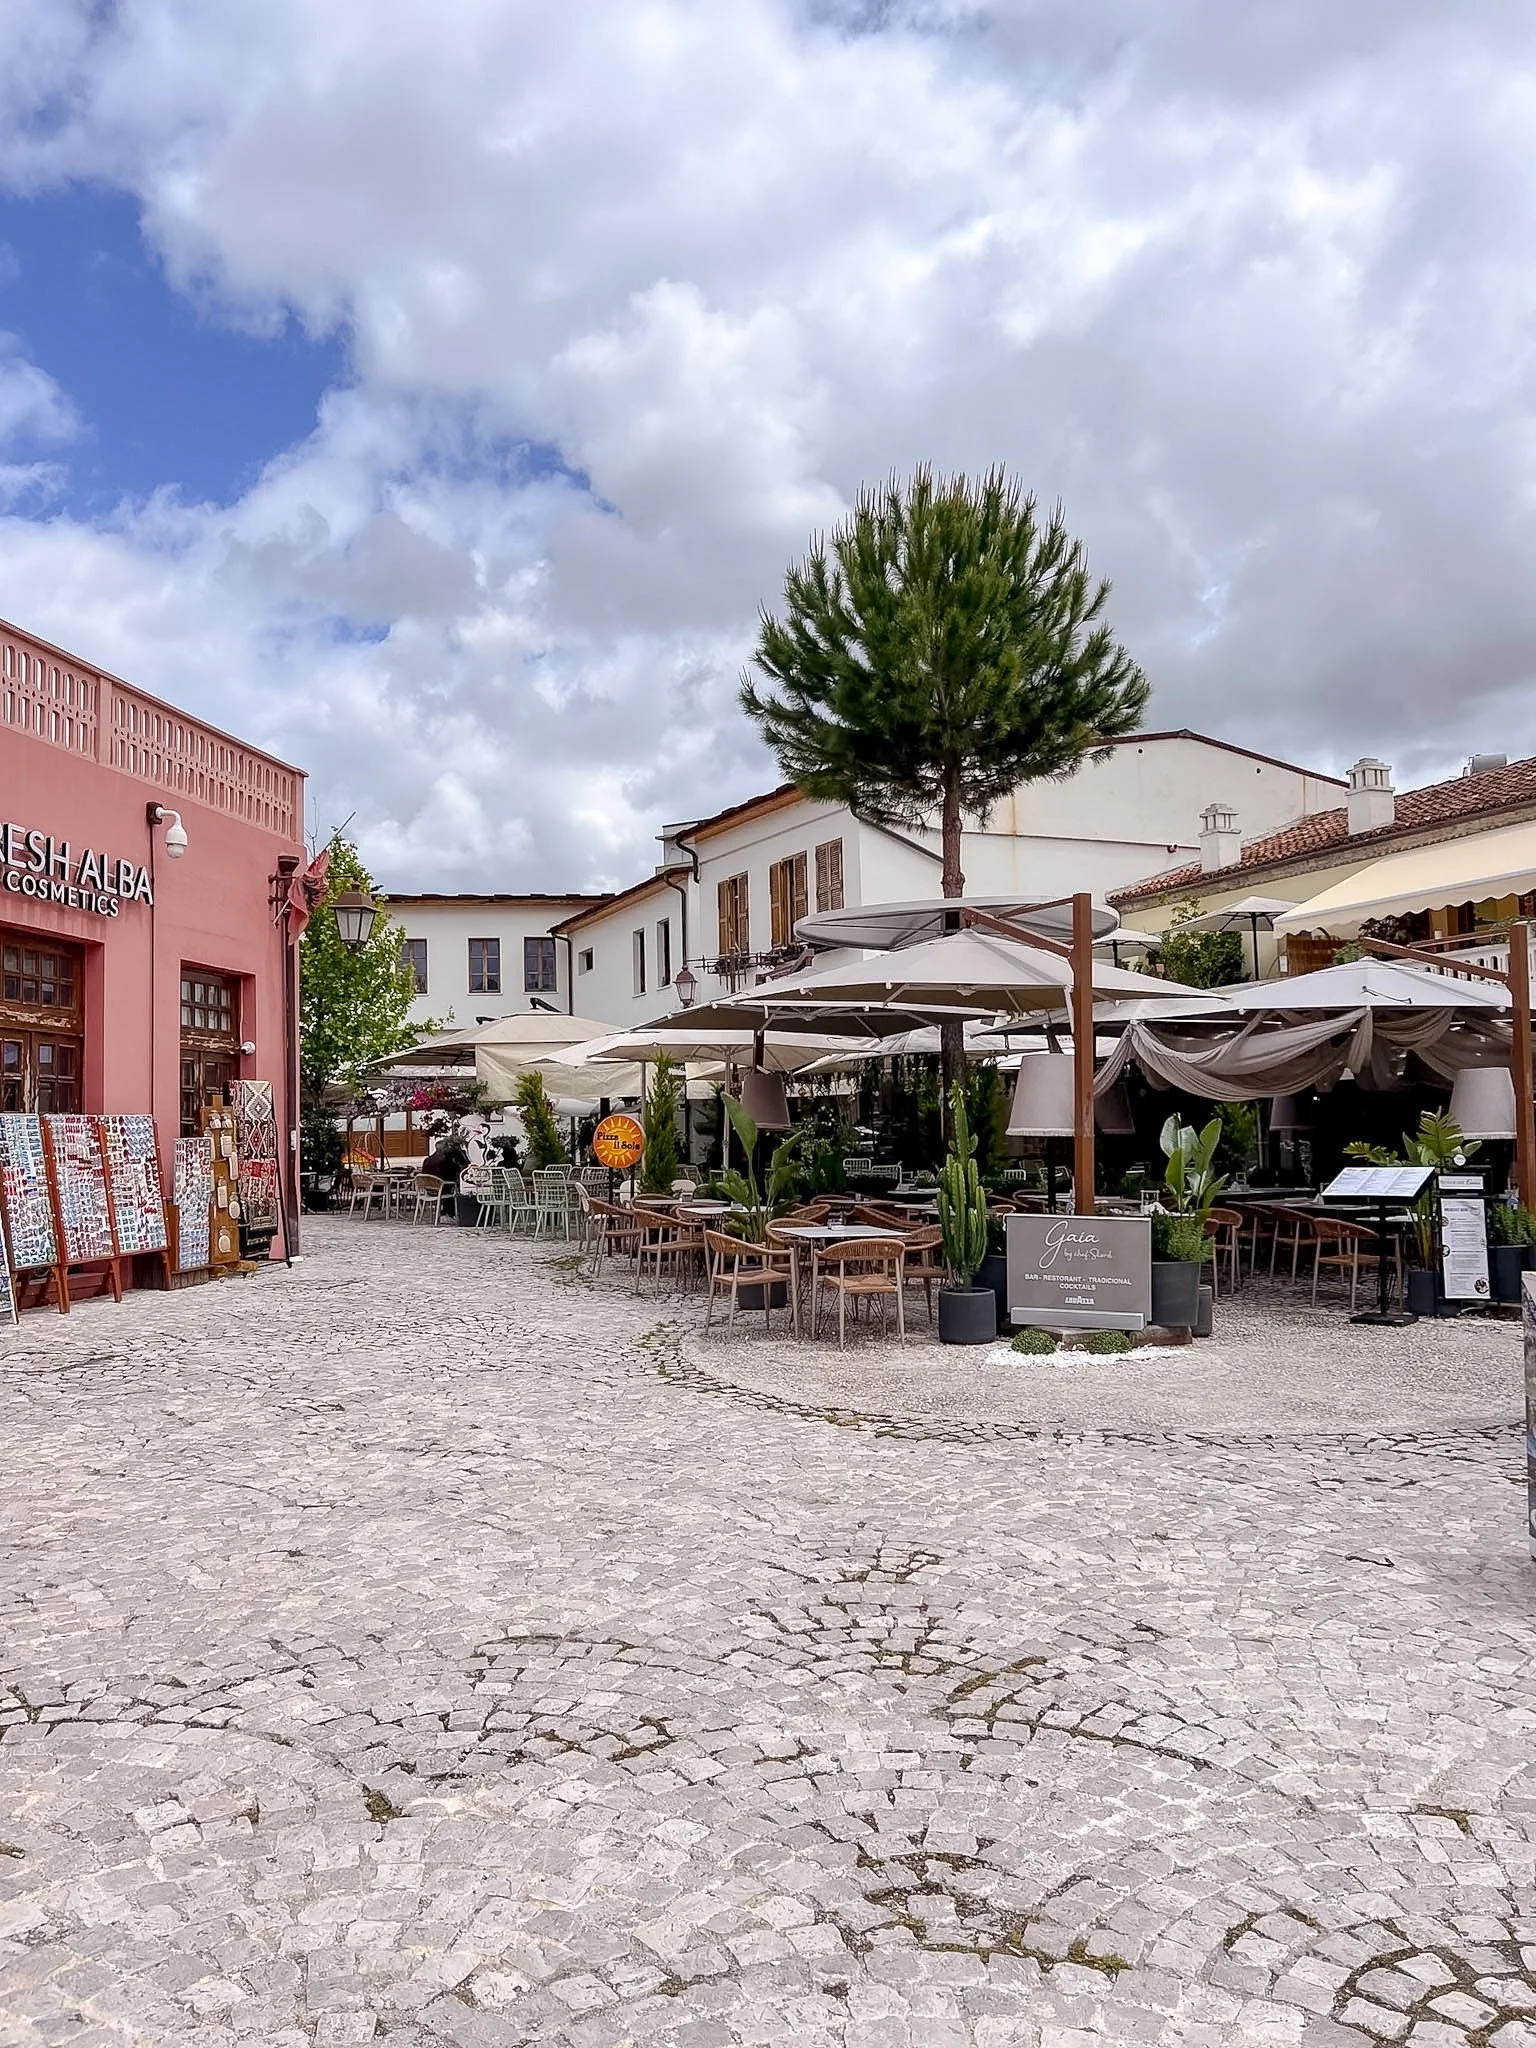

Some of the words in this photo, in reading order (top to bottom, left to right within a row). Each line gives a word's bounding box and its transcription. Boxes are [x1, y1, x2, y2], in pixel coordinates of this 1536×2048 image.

[78, 848, 153, 906] ALBA
[5, 870, 119, 918] COSMETICS
[1038, 1220, 1100, 1269] Gaia
[1064, 1248, 1073, 1262] by
[1024, 1273, 1039, 1281] BAR
[1043, 1273, 1082, 1283] RESTORANT
[1089, 1276, 1132, 1286] TRADICIONAL
[1059, 1282, 1097, 1291] COCKTAILS
